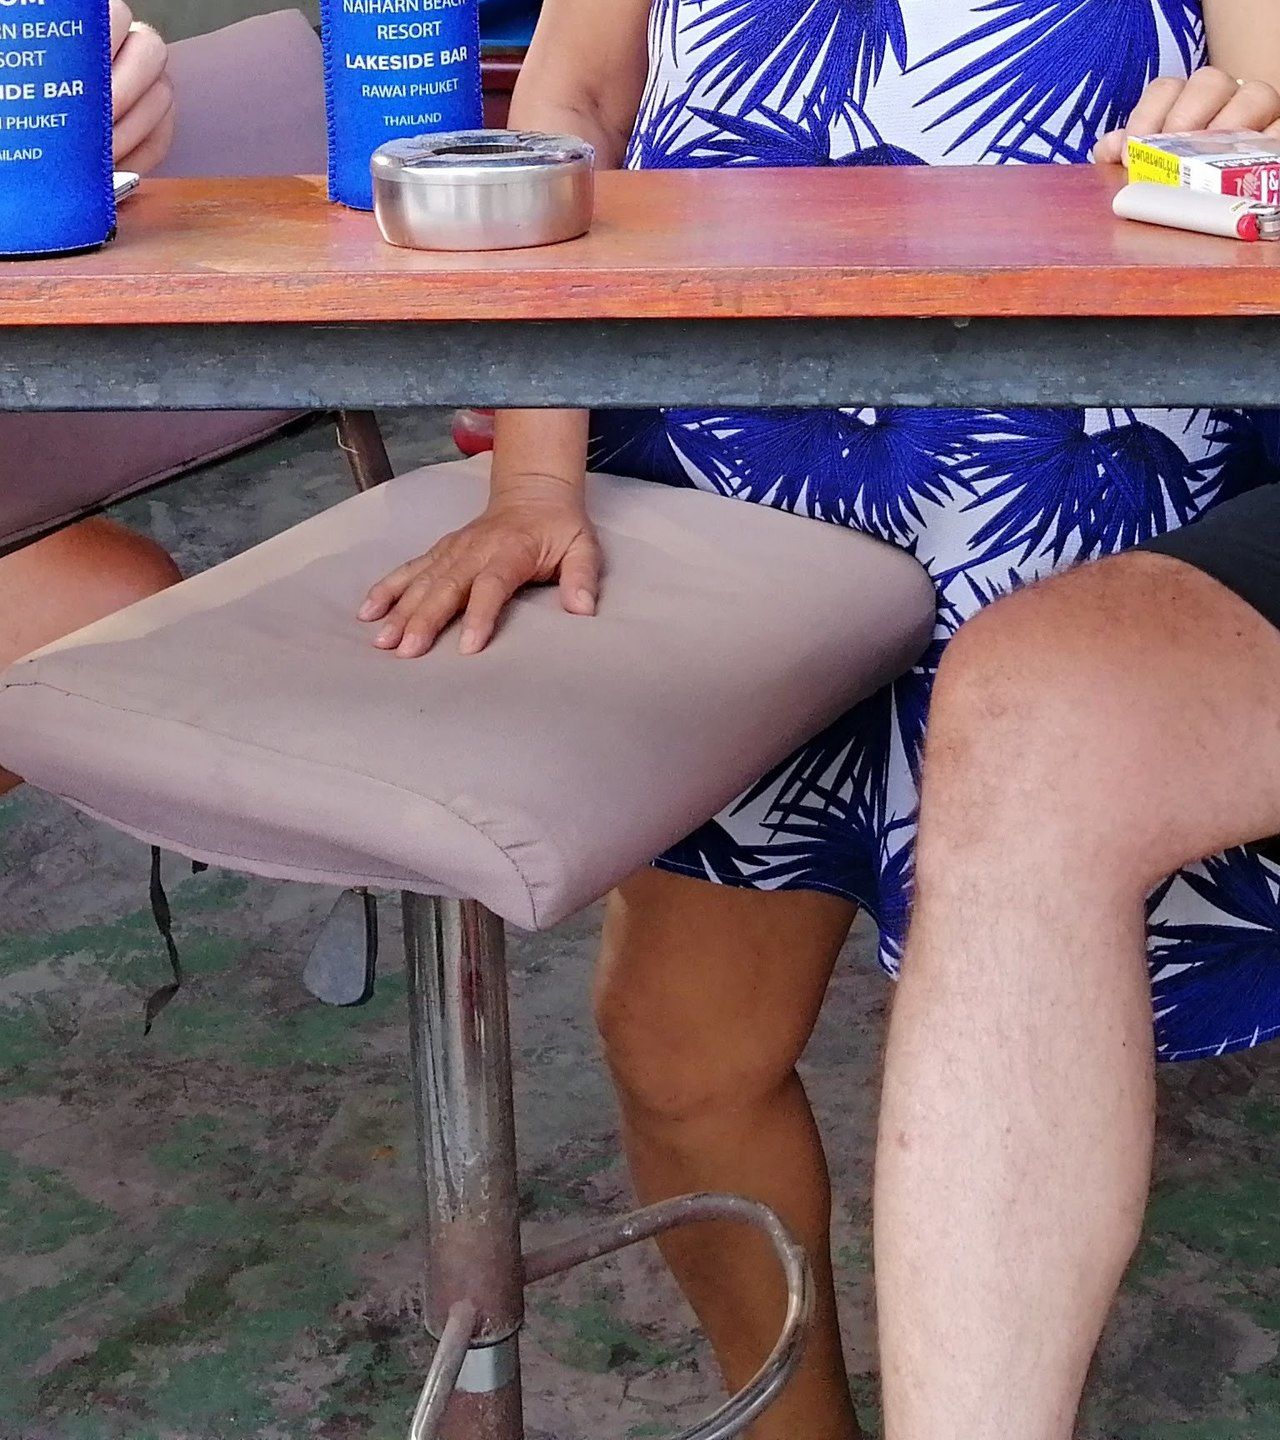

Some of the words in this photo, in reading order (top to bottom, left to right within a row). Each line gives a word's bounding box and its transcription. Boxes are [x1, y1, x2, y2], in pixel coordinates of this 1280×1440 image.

[22, 19, 84, 38] BEACH
[377, 20, 442, 40] RESORT
[345, 52, 434, 71] LAKESIDE
[439, 46, 468, 65] BAR
[44, 80, 84, 99] BAR
[362, 82, 407, 98] RAWAI
[410, 77, 459, 96] PHUKET
[7, 112, 68, 130] PHUKET
[383, 112, 442, 127] THAILAND
